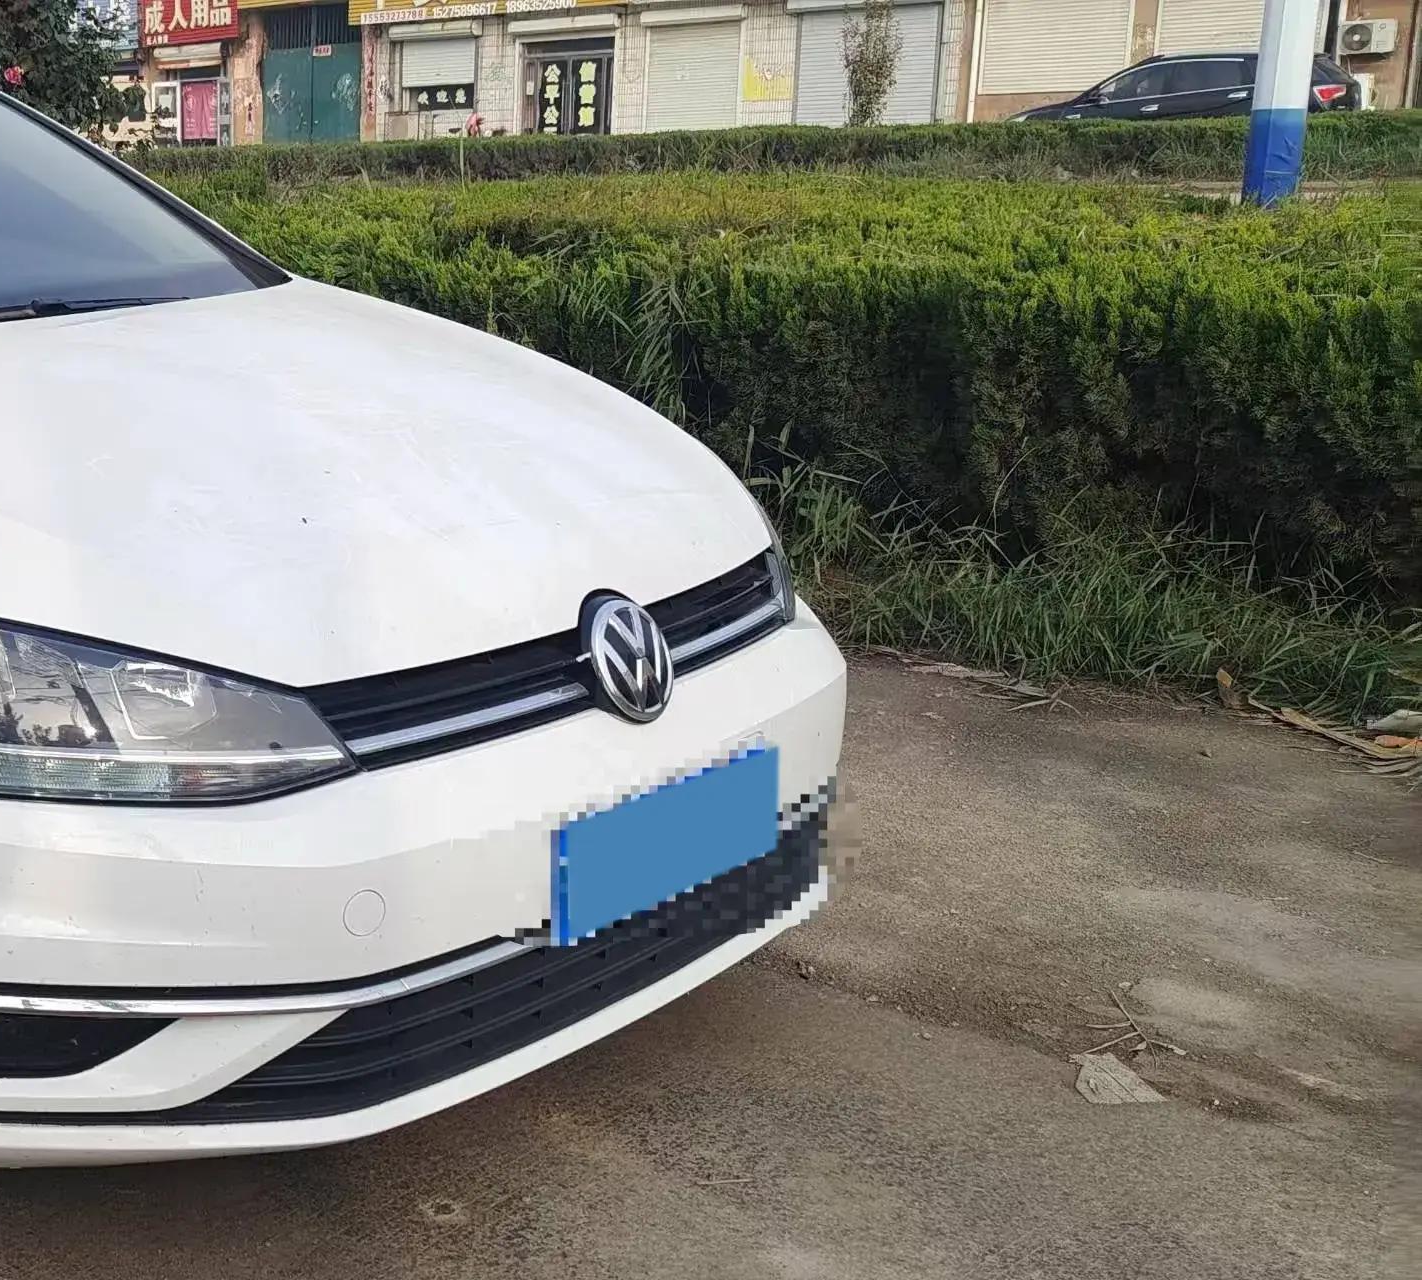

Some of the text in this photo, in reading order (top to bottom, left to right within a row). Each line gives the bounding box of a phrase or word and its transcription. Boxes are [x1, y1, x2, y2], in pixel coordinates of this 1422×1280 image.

[144, 0, 232, 34] 成人用品
[432, 3, 497, 18] 15275896617
[543, 63, 561, 133] 公平公
